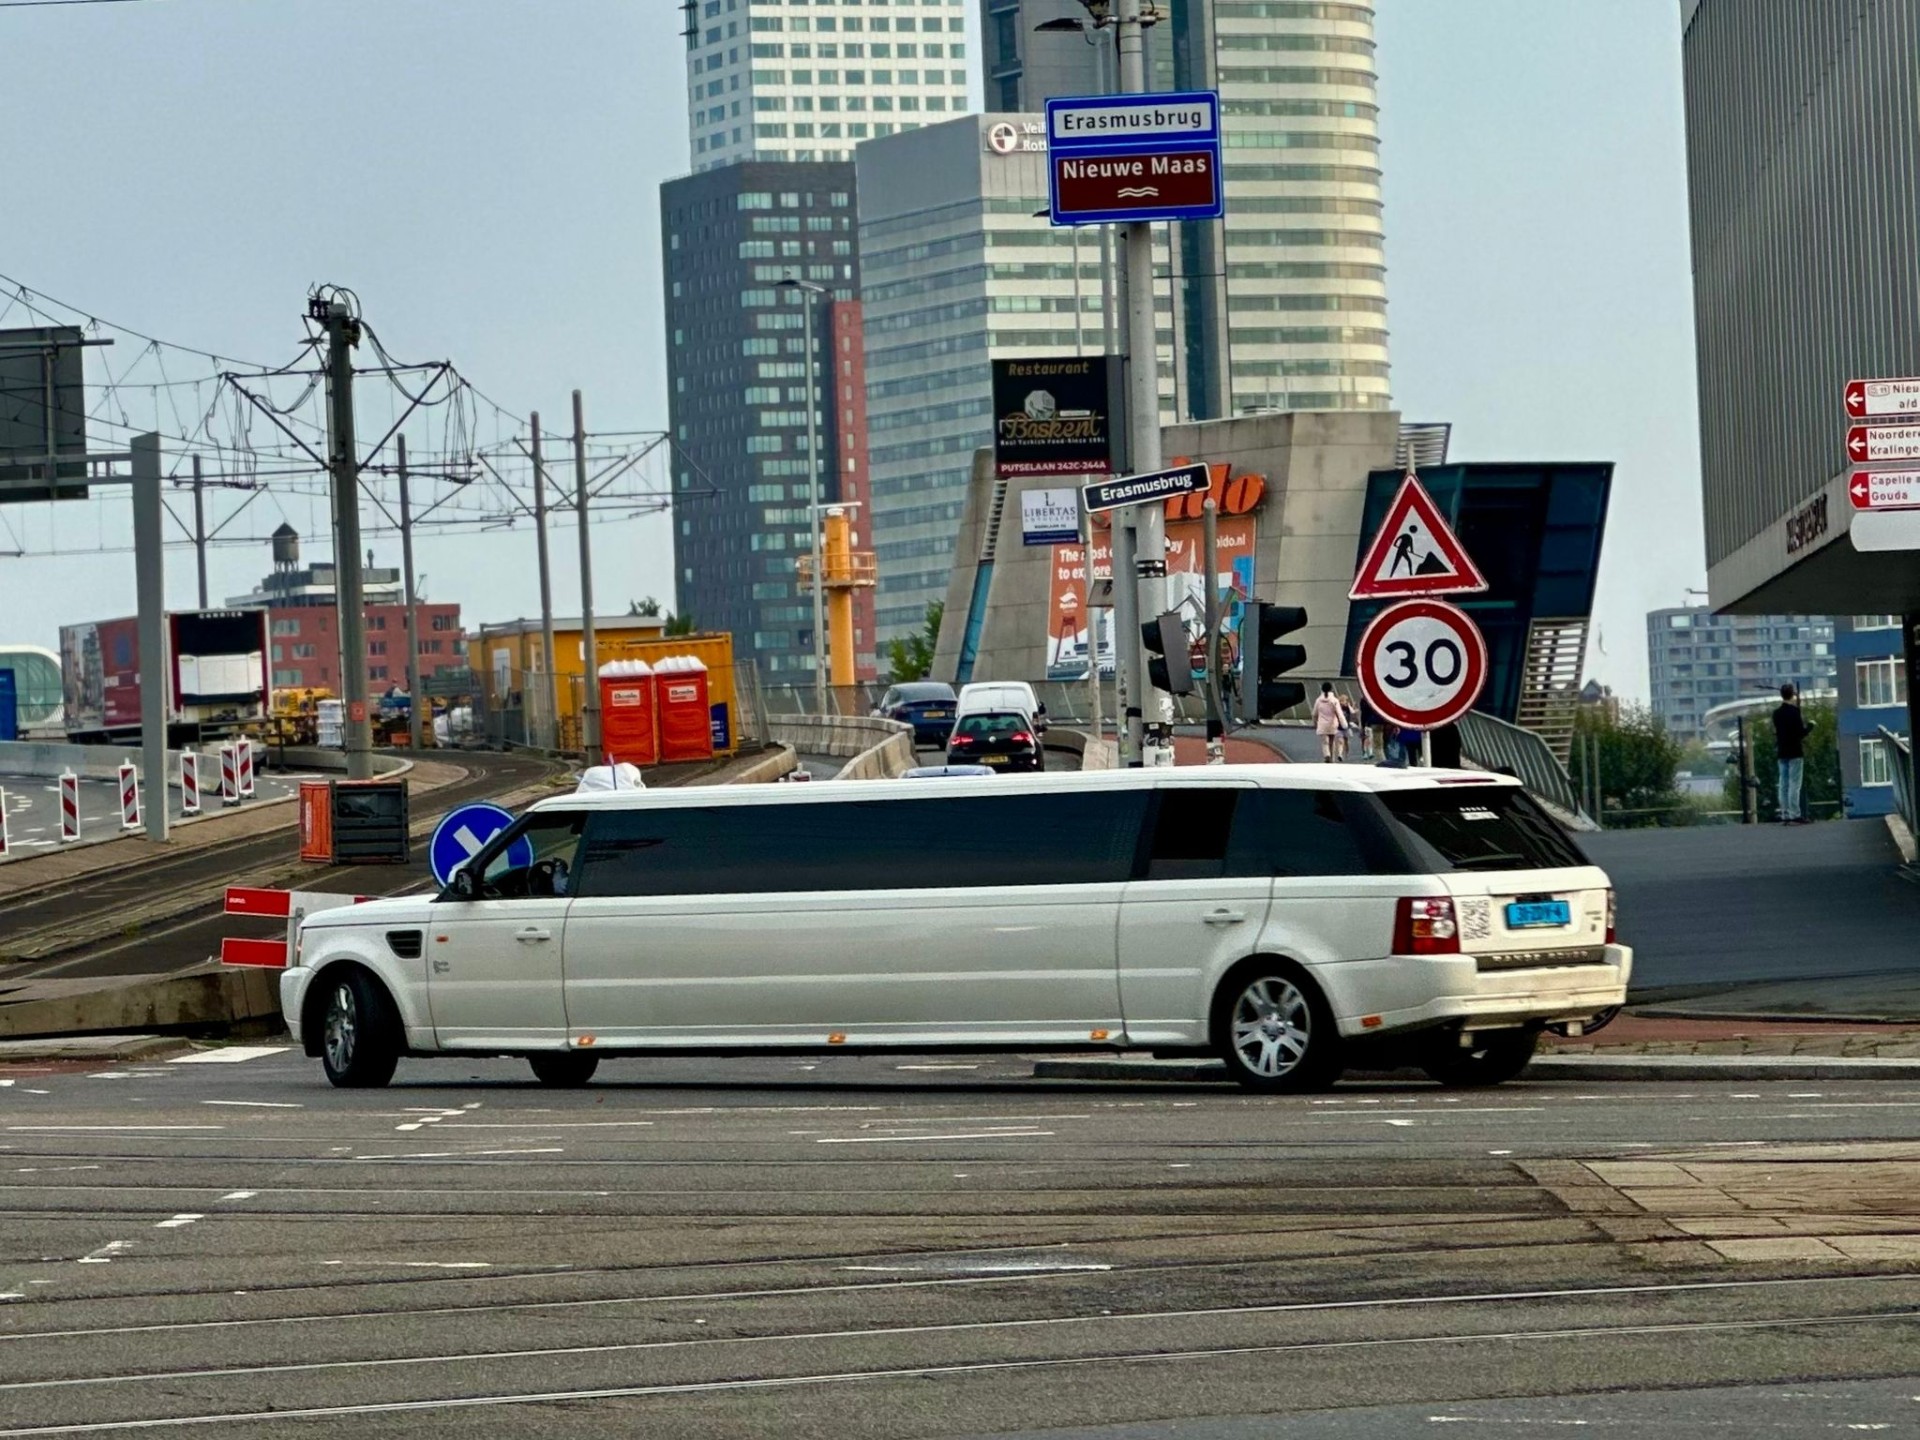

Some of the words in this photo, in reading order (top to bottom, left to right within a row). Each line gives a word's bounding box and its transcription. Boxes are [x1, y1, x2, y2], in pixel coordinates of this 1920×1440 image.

[1063, 110, 1202, 130] Erasmusbrug
[1063, 160, 1143, 179] Nieuwe
[1151, 156, 1207, 175] Maas
[1008, 362, 1089, 376] Restaurant
[1893, 384, 1919, 394] Nieu
[1899, 399, 1918, 408] a/d
[1870, 445, 1919, 455] Kralinge
[1001, 462, 1055, 472] PUTSELAAN
[1057, 461, 1106, 470] 242C-244A
[1870, 475, 1912, 486] Capelle
[1100, 474, 1193, 502] Erasmusbrug
[1871, 490, 1908, 501] Gouda
[1024, 506, 1076, 517] LIBERTAS
[1216, 533, 1246, 548] ido.nl
[1059, 549, 1079, 562] The
[1170, 540, 1184, 554] ay
[1058, 567, 1070, 580] to
[1072, 565, 1111, 580] exore
[1383, 638, 1462, 688] 30
